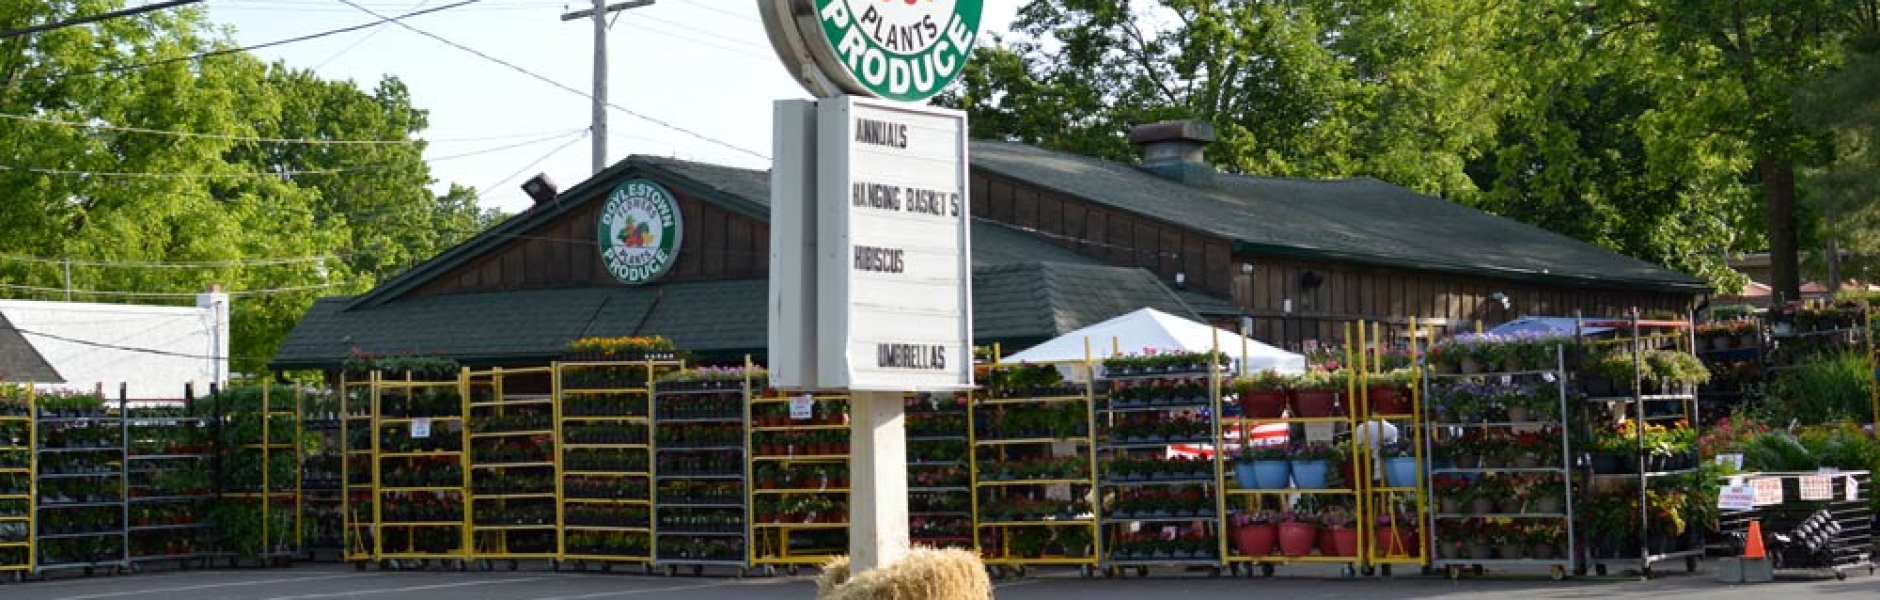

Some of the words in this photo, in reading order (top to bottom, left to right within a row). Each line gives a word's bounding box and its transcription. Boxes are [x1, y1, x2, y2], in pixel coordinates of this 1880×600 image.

[861, 5, 937, 51] PLANTS
[821, 0, 973, 94] PRODUCE
[856, 118, 907, 148] ANNUALS
[603, 184, 673, 227] DOYLESTOWN
[853, 182, 901, 211] HANGING
[604, 248, 668, 280] PRODUCE
[854, 245, 905, 273] HIBISCUS
[878, 342, 946, 370] UMBRELLAS
